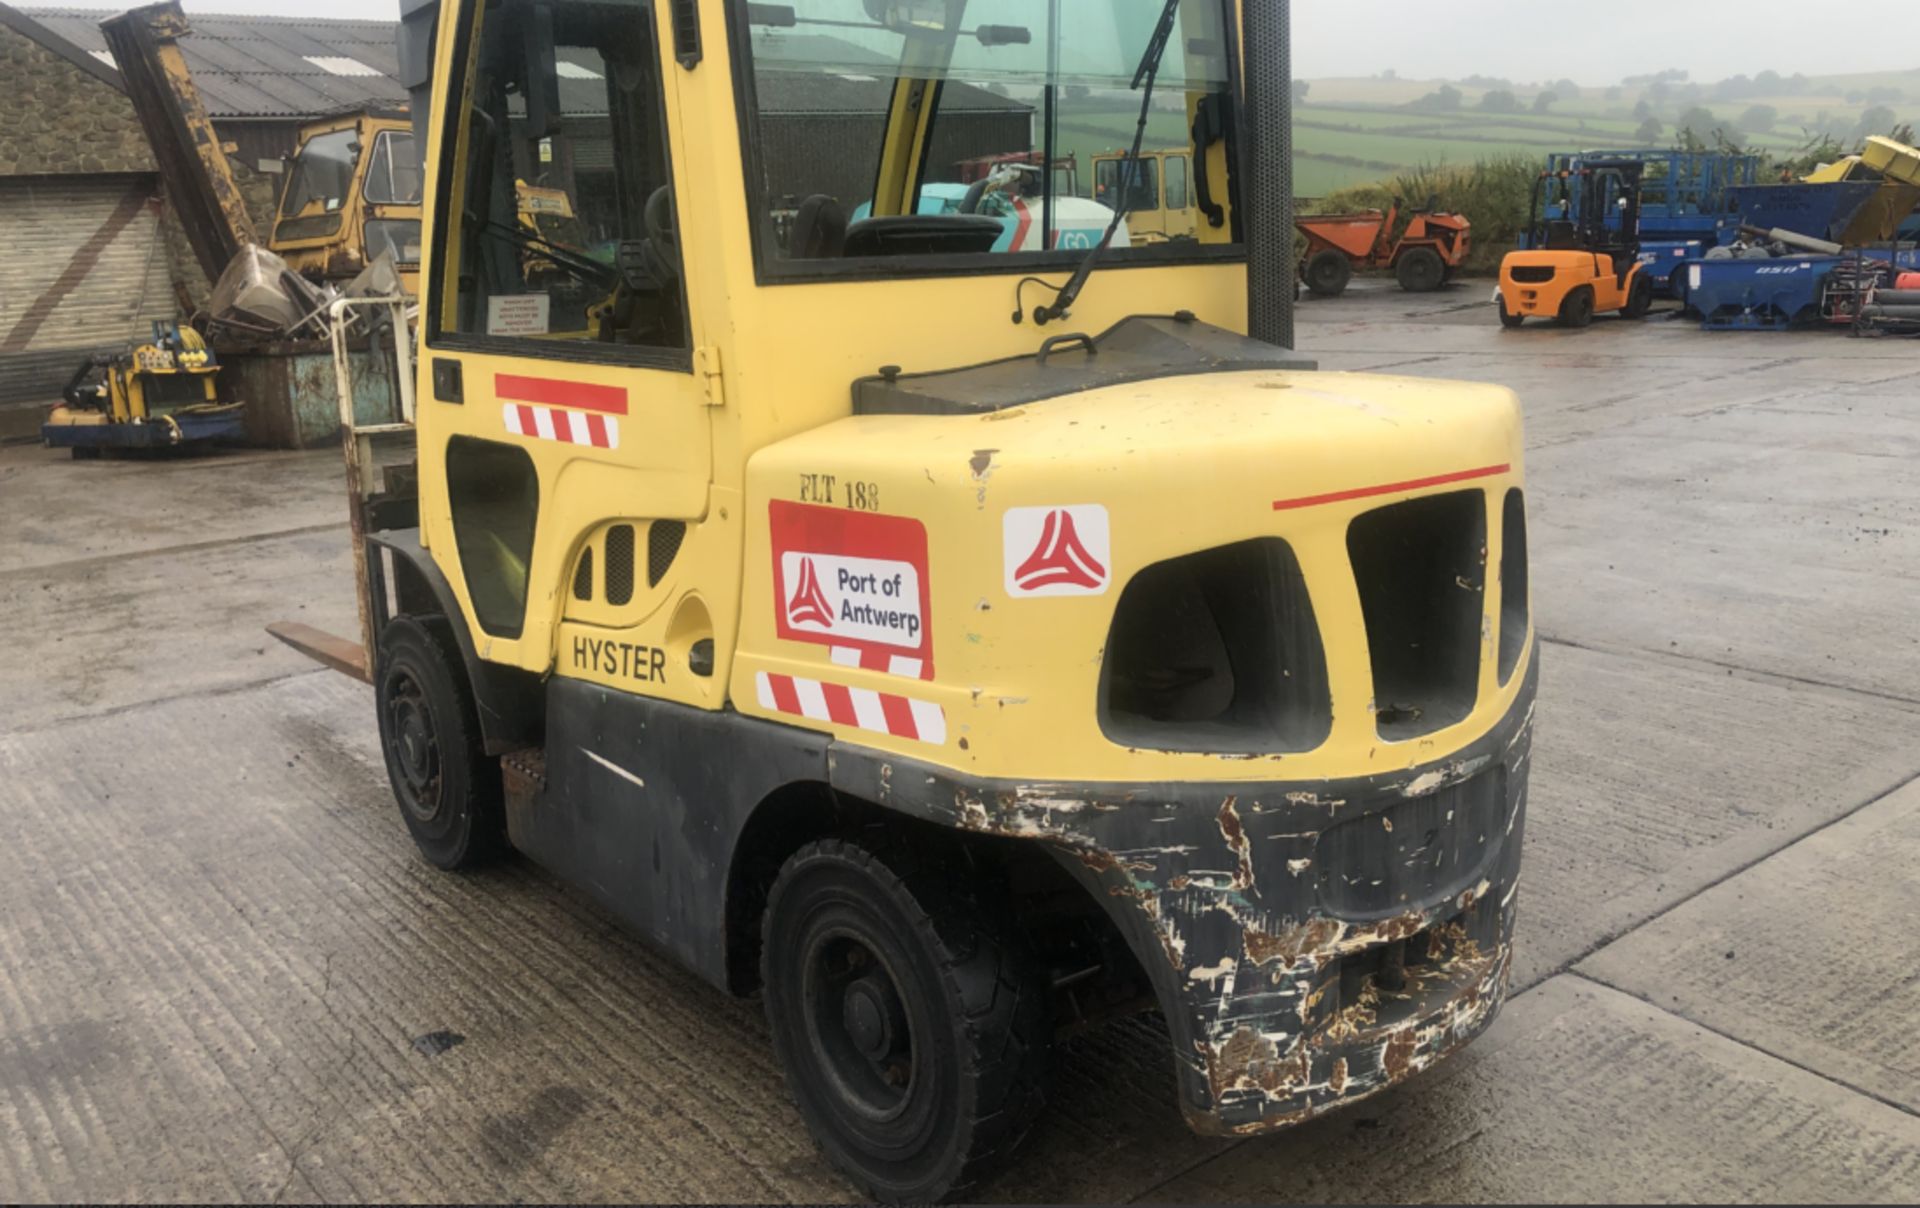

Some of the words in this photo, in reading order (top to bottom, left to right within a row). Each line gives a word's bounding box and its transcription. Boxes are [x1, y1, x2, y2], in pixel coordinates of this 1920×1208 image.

[799, 473, 836, 503] FLT
[844, 480, 879, 511] 188
[838, 567, 877, 595] Port
[882, 573, 902, 598] of
[841, 598, 920, 637] Antwerp
[573, 635, 666, 684] HYSTER
